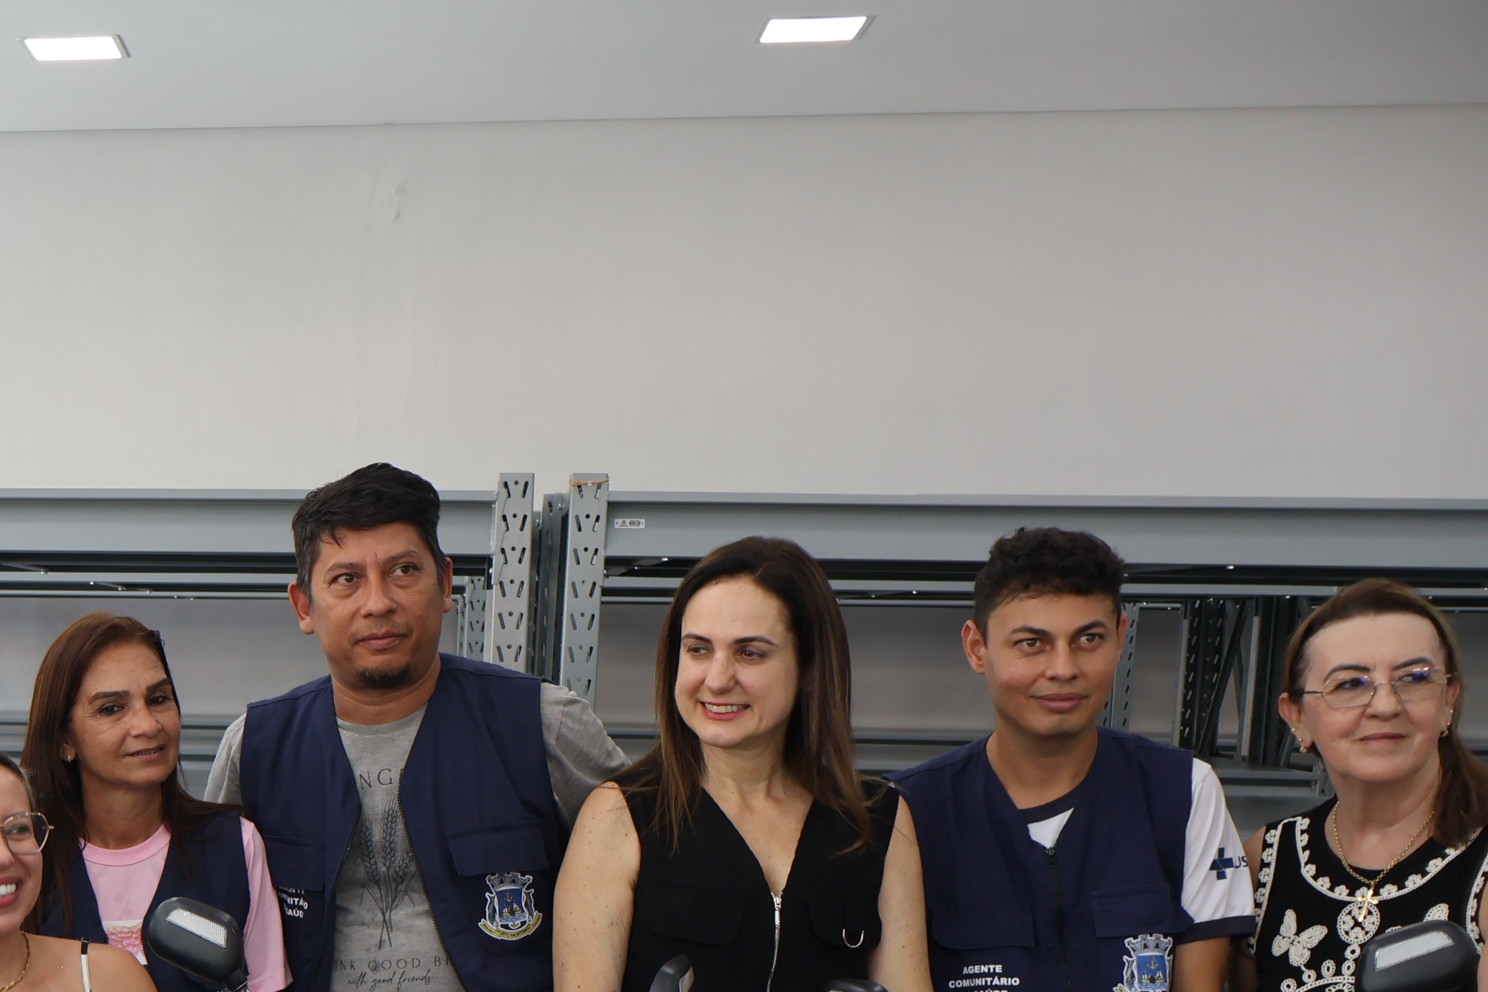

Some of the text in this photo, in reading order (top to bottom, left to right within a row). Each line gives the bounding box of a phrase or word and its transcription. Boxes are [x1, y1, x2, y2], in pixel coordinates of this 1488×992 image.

[368, 958, 421, 971] GOOD
[962, 964, 1003, 975] AGENTE
[347, 971, 368, 989] with
[369, 970, 397, 992] good
[948, 976, 1020, 989] COMUNITÁRIO
